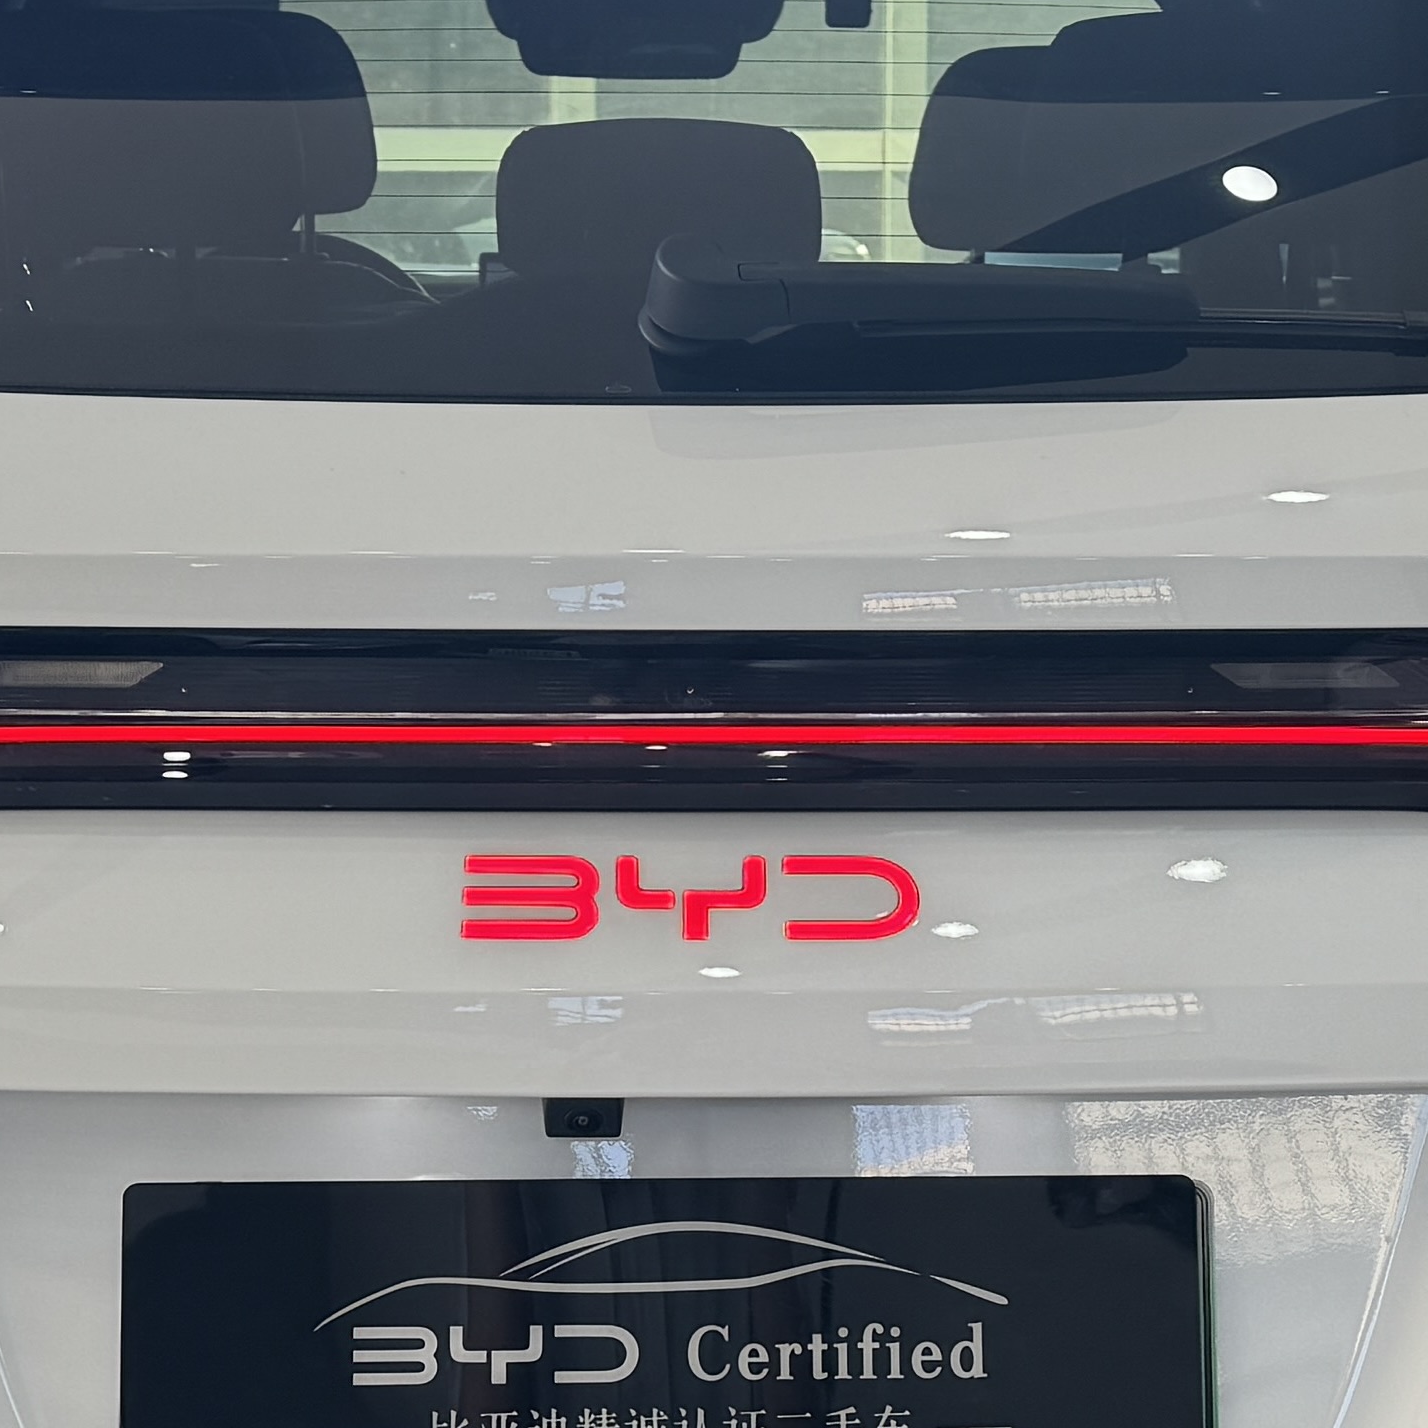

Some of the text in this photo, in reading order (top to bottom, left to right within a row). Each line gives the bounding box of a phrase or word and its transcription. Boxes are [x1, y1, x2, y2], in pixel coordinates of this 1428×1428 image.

[461, 853, 921, 941] BYD
[352, 1321, 988, 1386] BYD Certified
